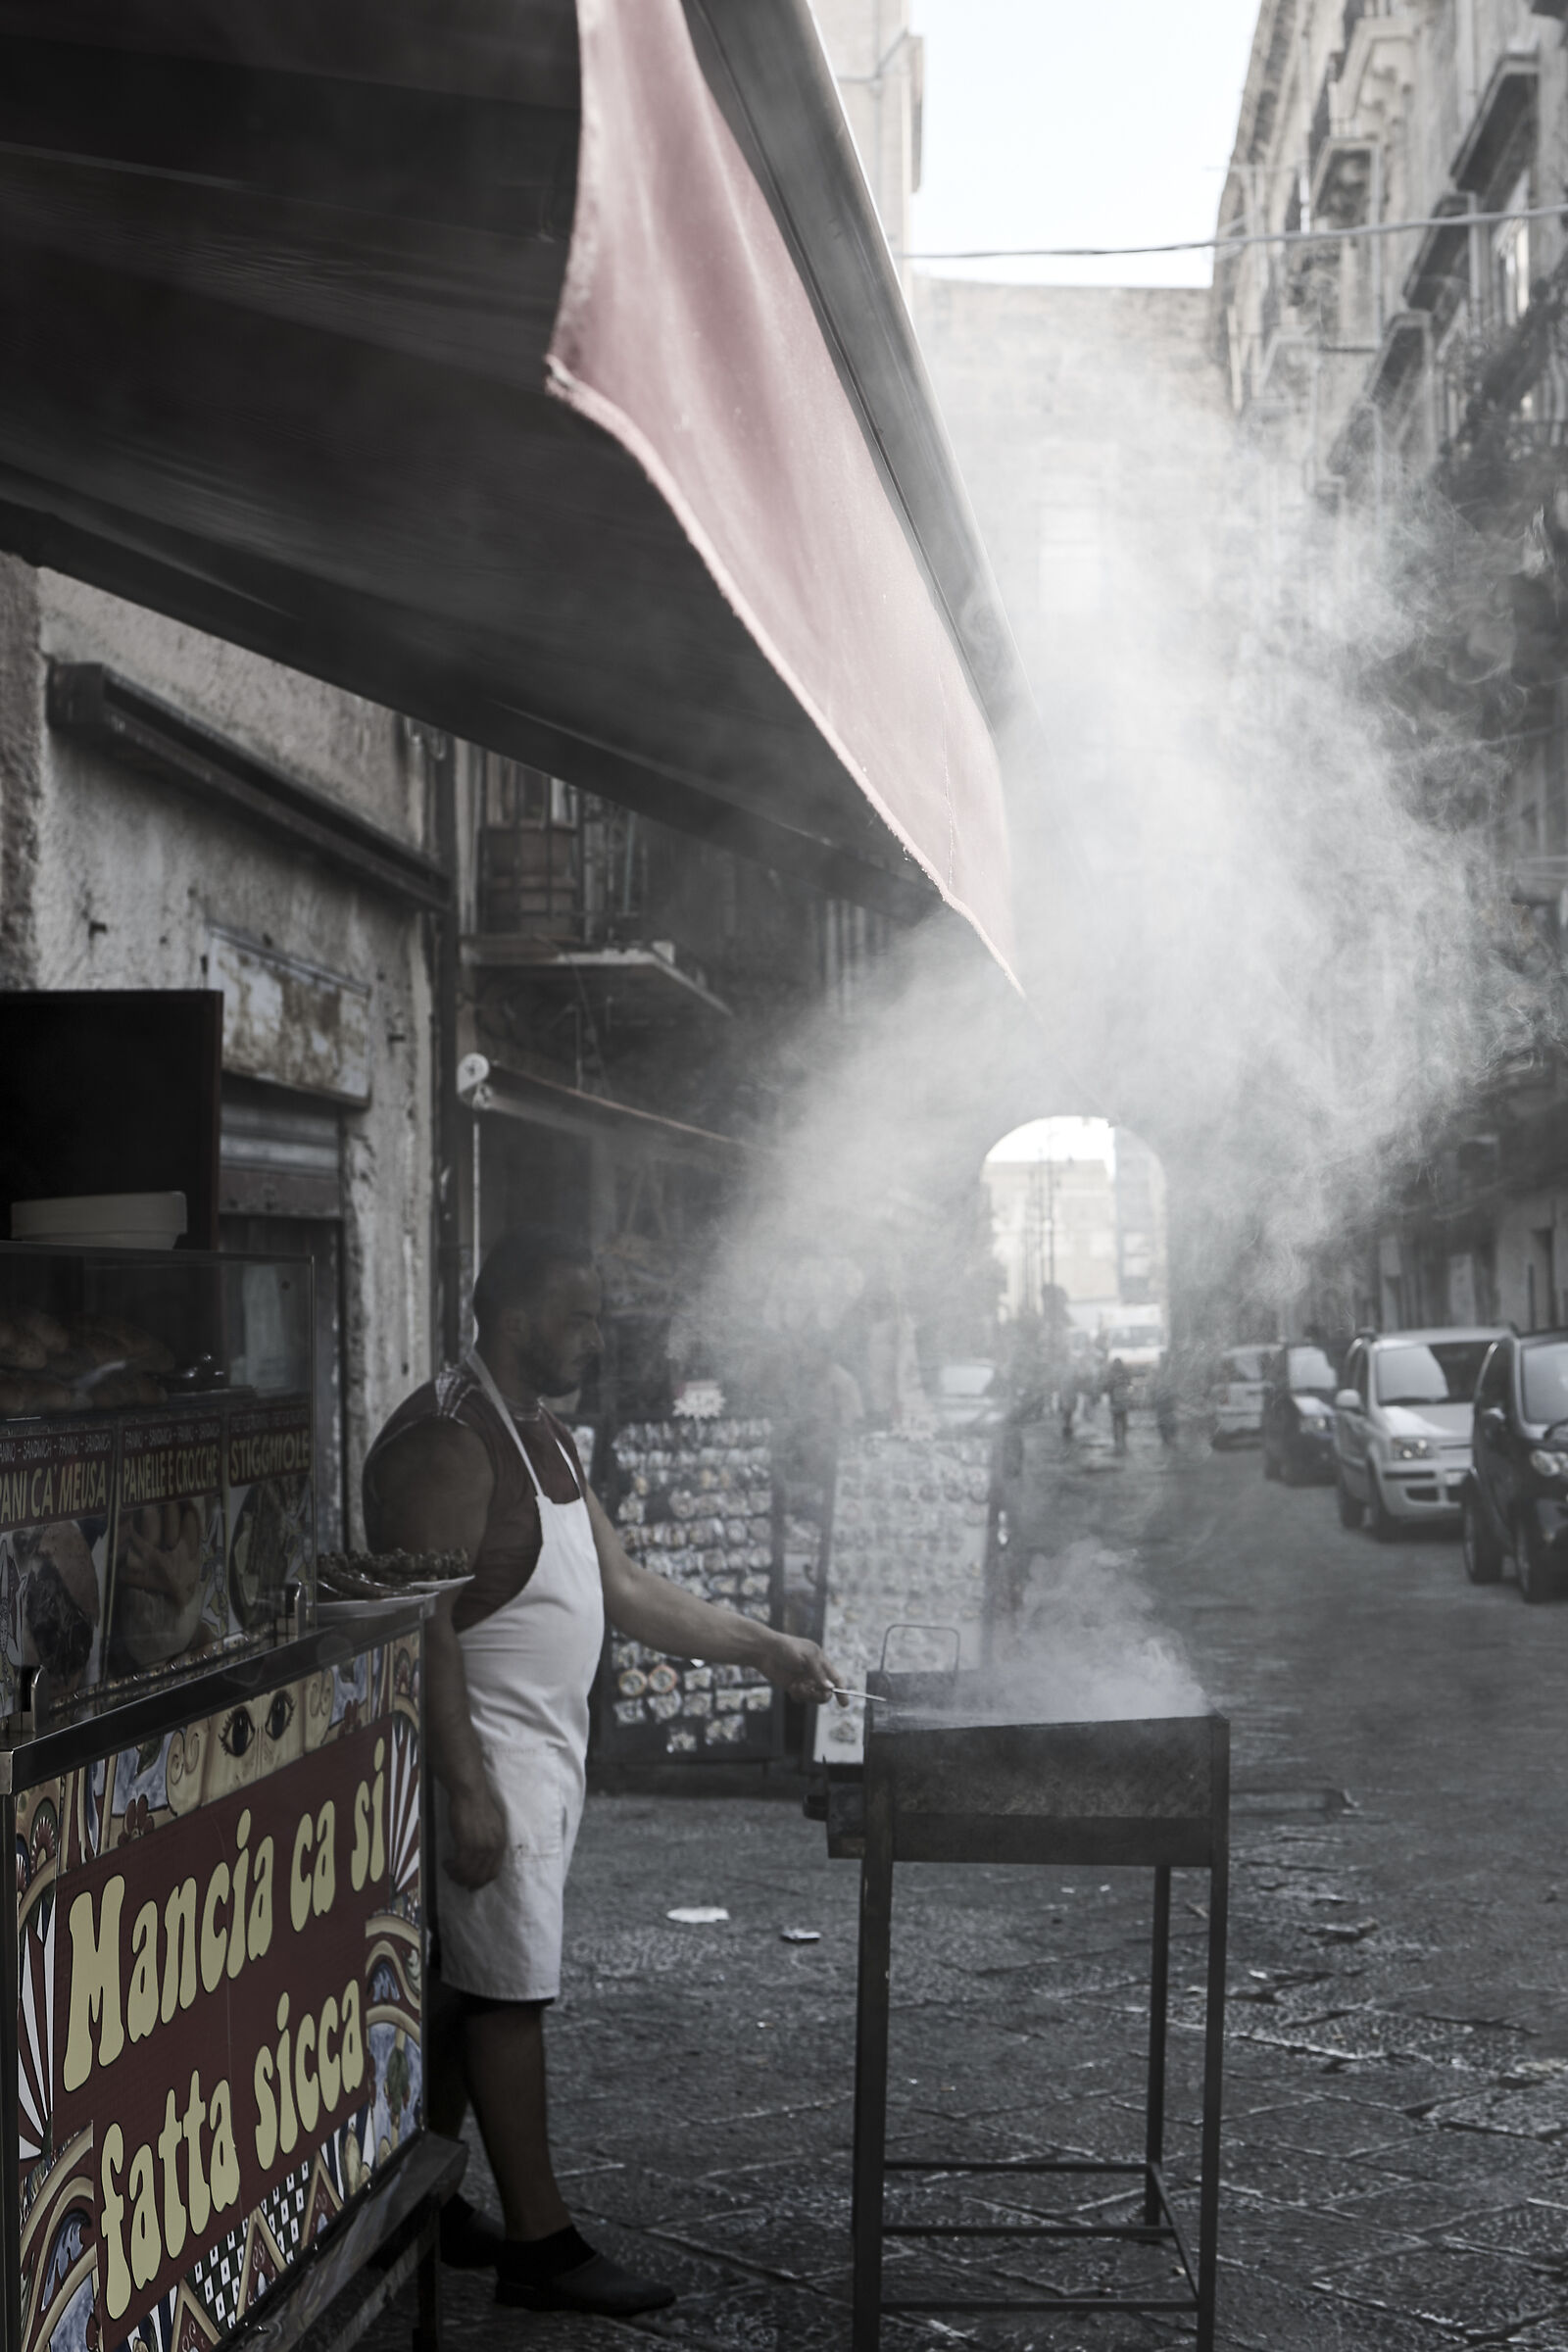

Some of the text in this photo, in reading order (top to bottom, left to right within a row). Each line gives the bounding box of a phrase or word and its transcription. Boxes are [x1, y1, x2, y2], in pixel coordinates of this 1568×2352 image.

[123, 1452, 166, 1503] PANELLE
[168, 1450, 173, 1495] E
[231, 1431, 309, 1482] STIGGHIOLE
[31, 1463, 57, 1518] CA'
[59, 1460, 106, 1513] MEUSA
[62, 1737, 386, 2092] Mancia ca si
[99, 1978, 365, 2321] fatta sicca
